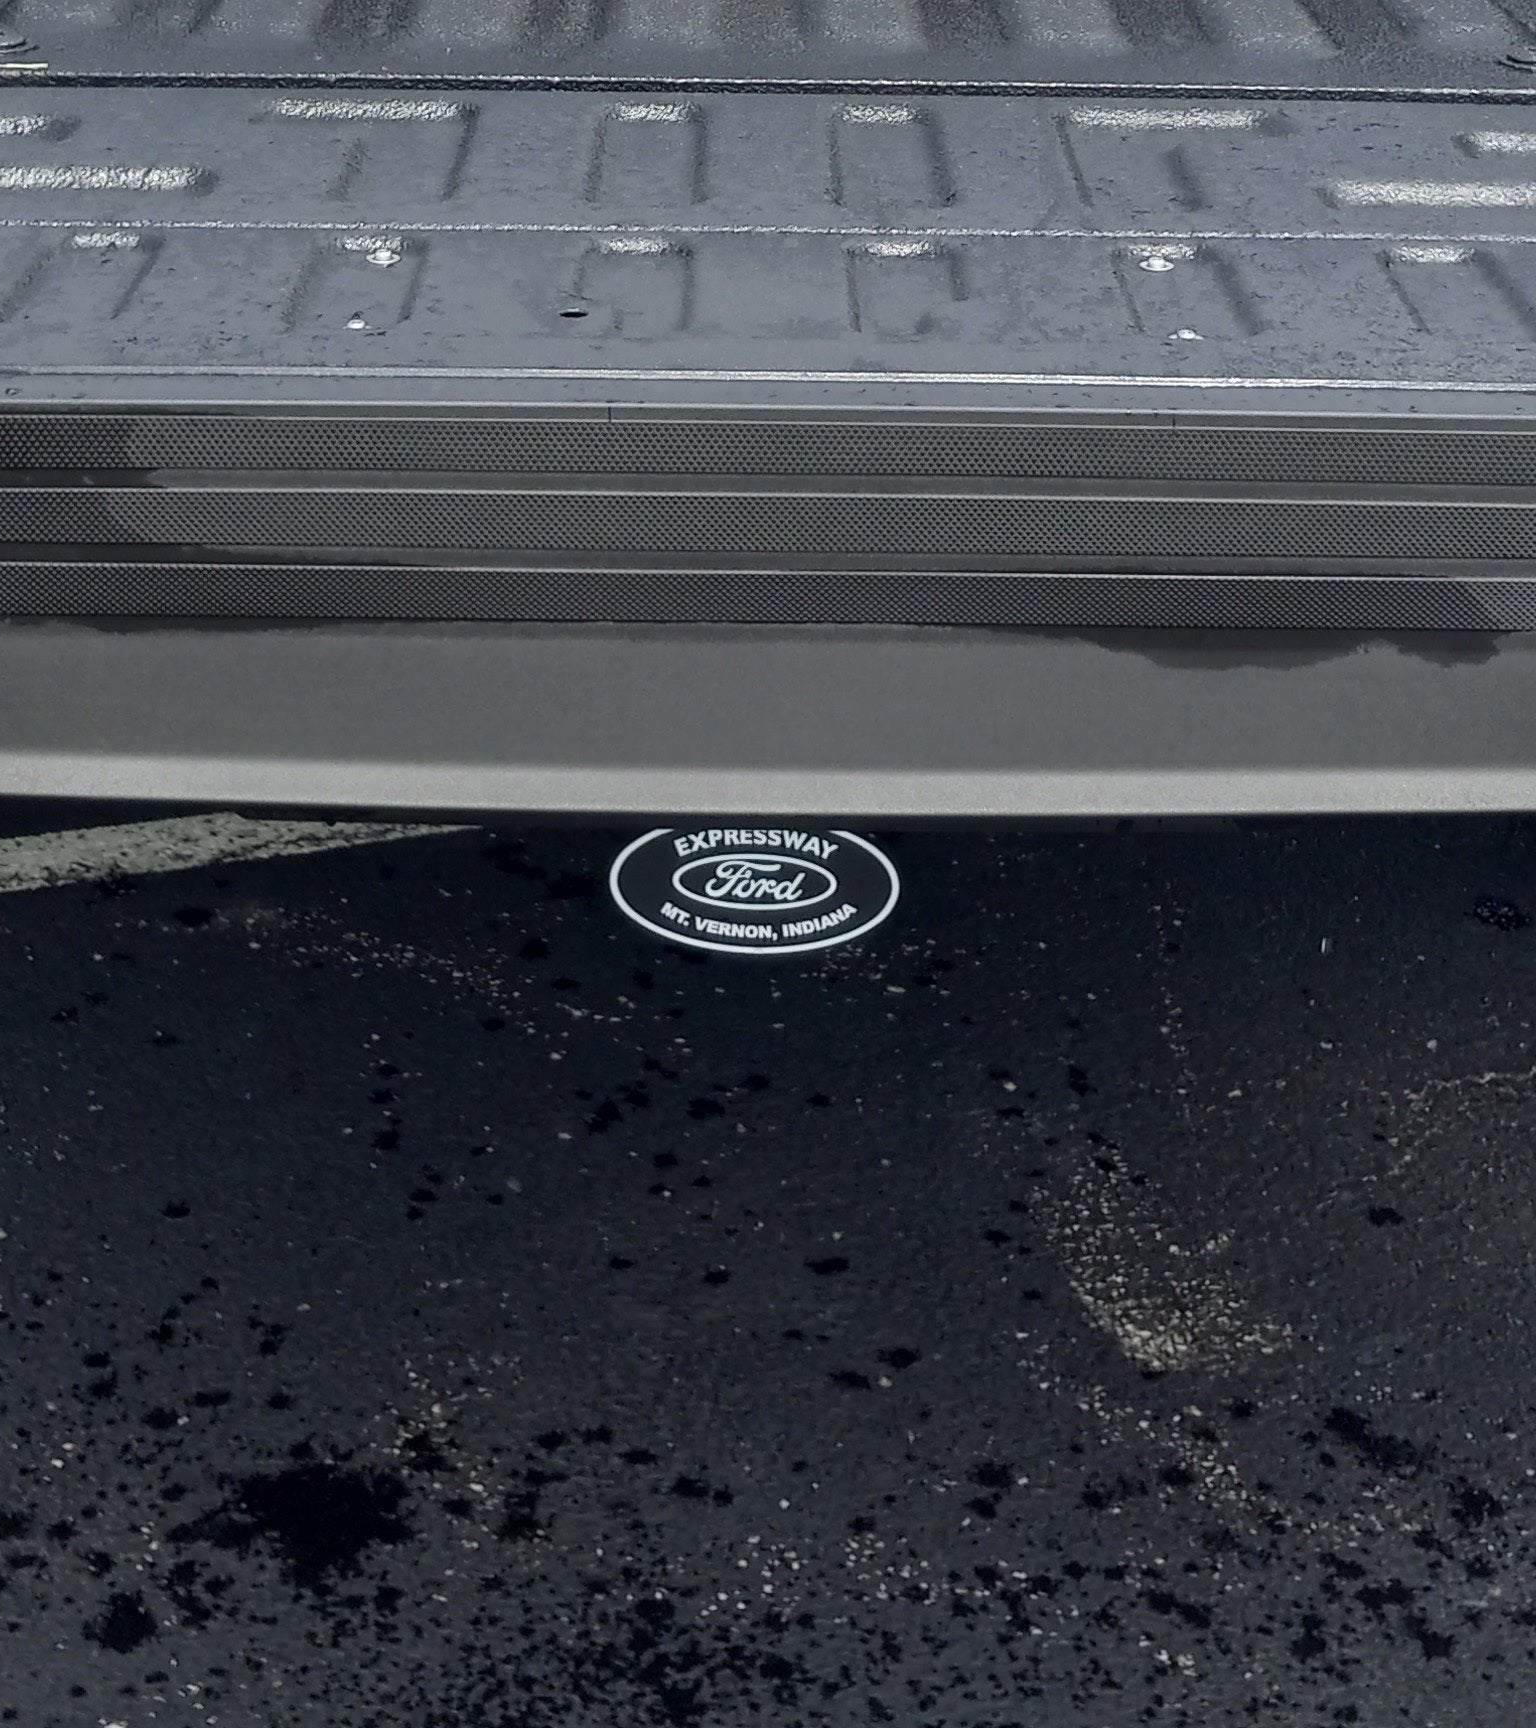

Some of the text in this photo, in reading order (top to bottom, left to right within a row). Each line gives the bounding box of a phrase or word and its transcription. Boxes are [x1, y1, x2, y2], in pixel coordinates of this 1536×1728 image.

[673, 829, 839, 860] EXPRESSWAY
[704, 860, 807, 902] Ford
[660, 902, 858, 941] MT. VERNON, INDIANA
